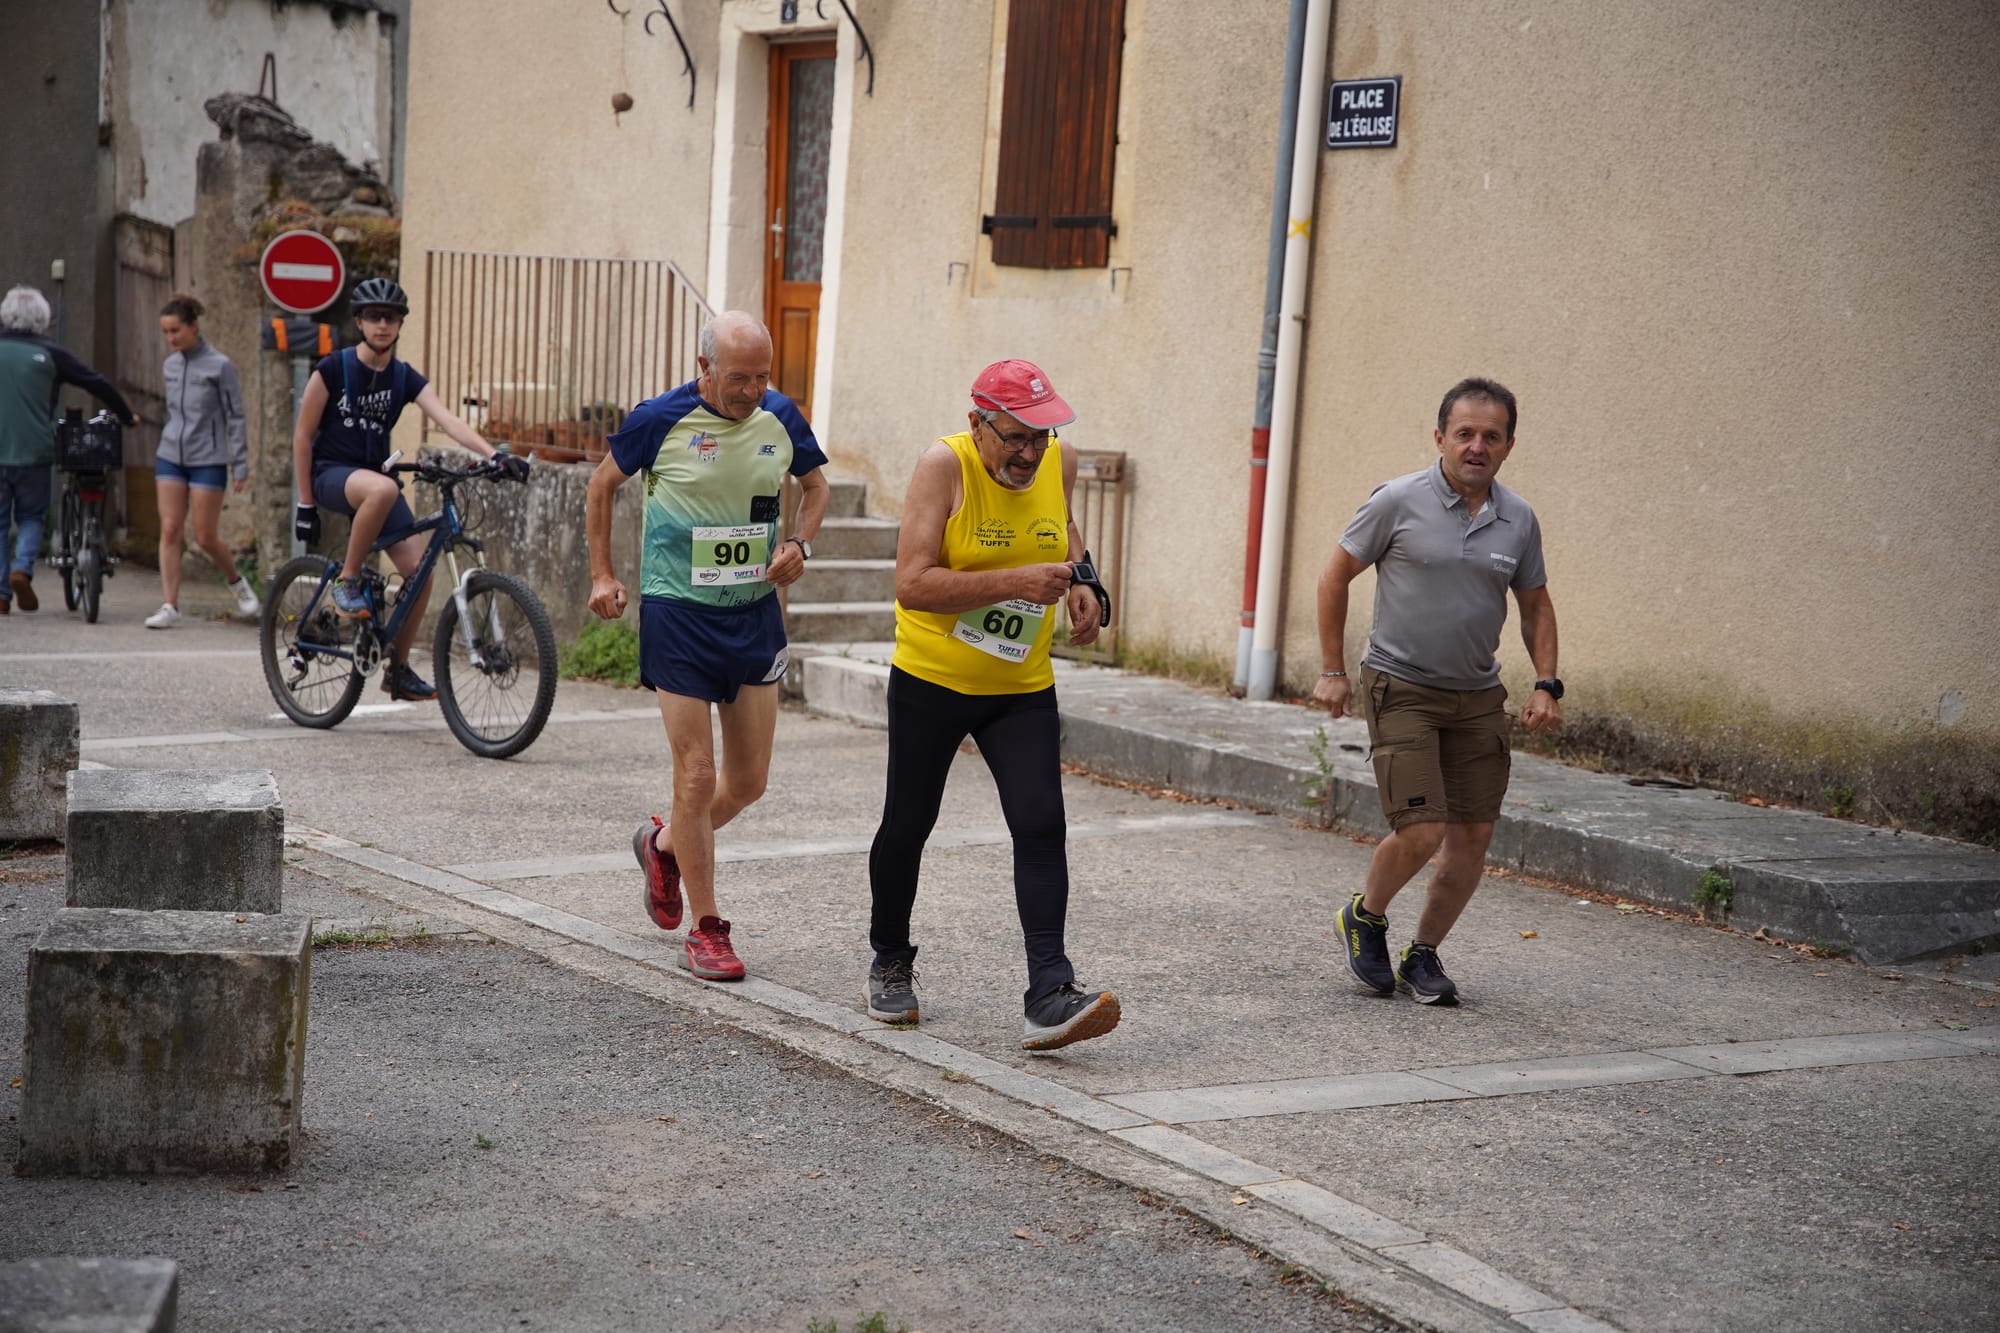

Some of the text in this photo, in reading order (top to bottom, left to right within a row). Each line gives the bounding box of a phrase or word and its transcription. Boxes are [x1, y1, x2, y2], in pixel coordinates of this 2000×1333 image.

[1340, 89, 1385, 109] PLACE
[1329, 113, 1392, 137] DE L'ÉGLISE
[1031, 390, 1049, 400] SEAT
[713, 541, 751, 567] 90
[982, 609, 1024, 640] 60
[998, 643, 1022, 654] TUFF'S
[1350, 928, 1361, 958] HOKA
